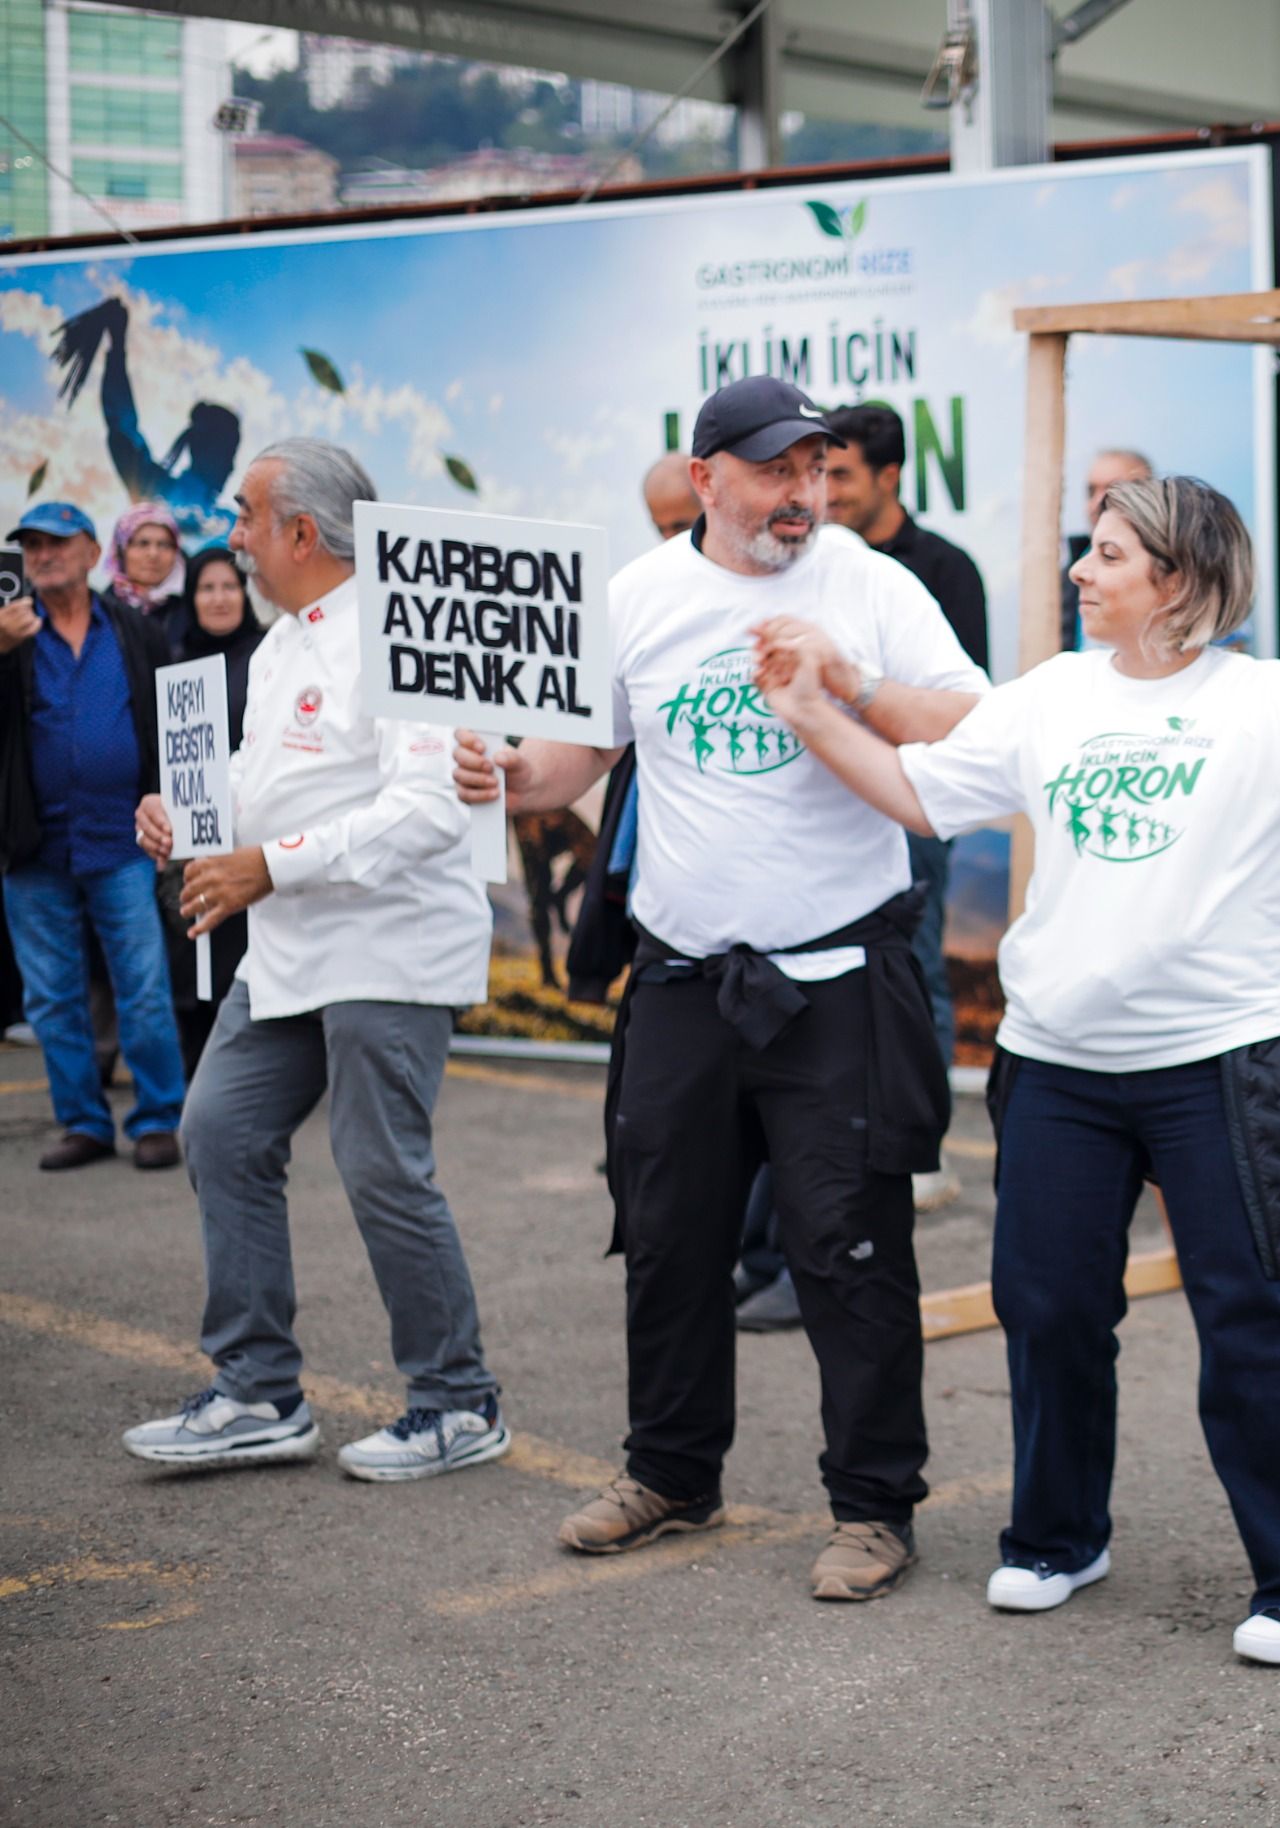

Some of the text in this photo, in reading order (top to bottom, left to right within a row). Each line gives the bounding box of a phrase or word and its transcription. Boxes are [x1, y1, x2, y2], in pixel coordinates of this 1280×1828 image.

[831, 317, 916, 396] İÇİN
[377, 529, 582, 603] KARBON
[389, 643, 529, 707] DENK
[536, 664, 592, 718] AL
[1043, 758, 1207, 820] HORON
[1081, 751, 1120, 766] İKLİM
